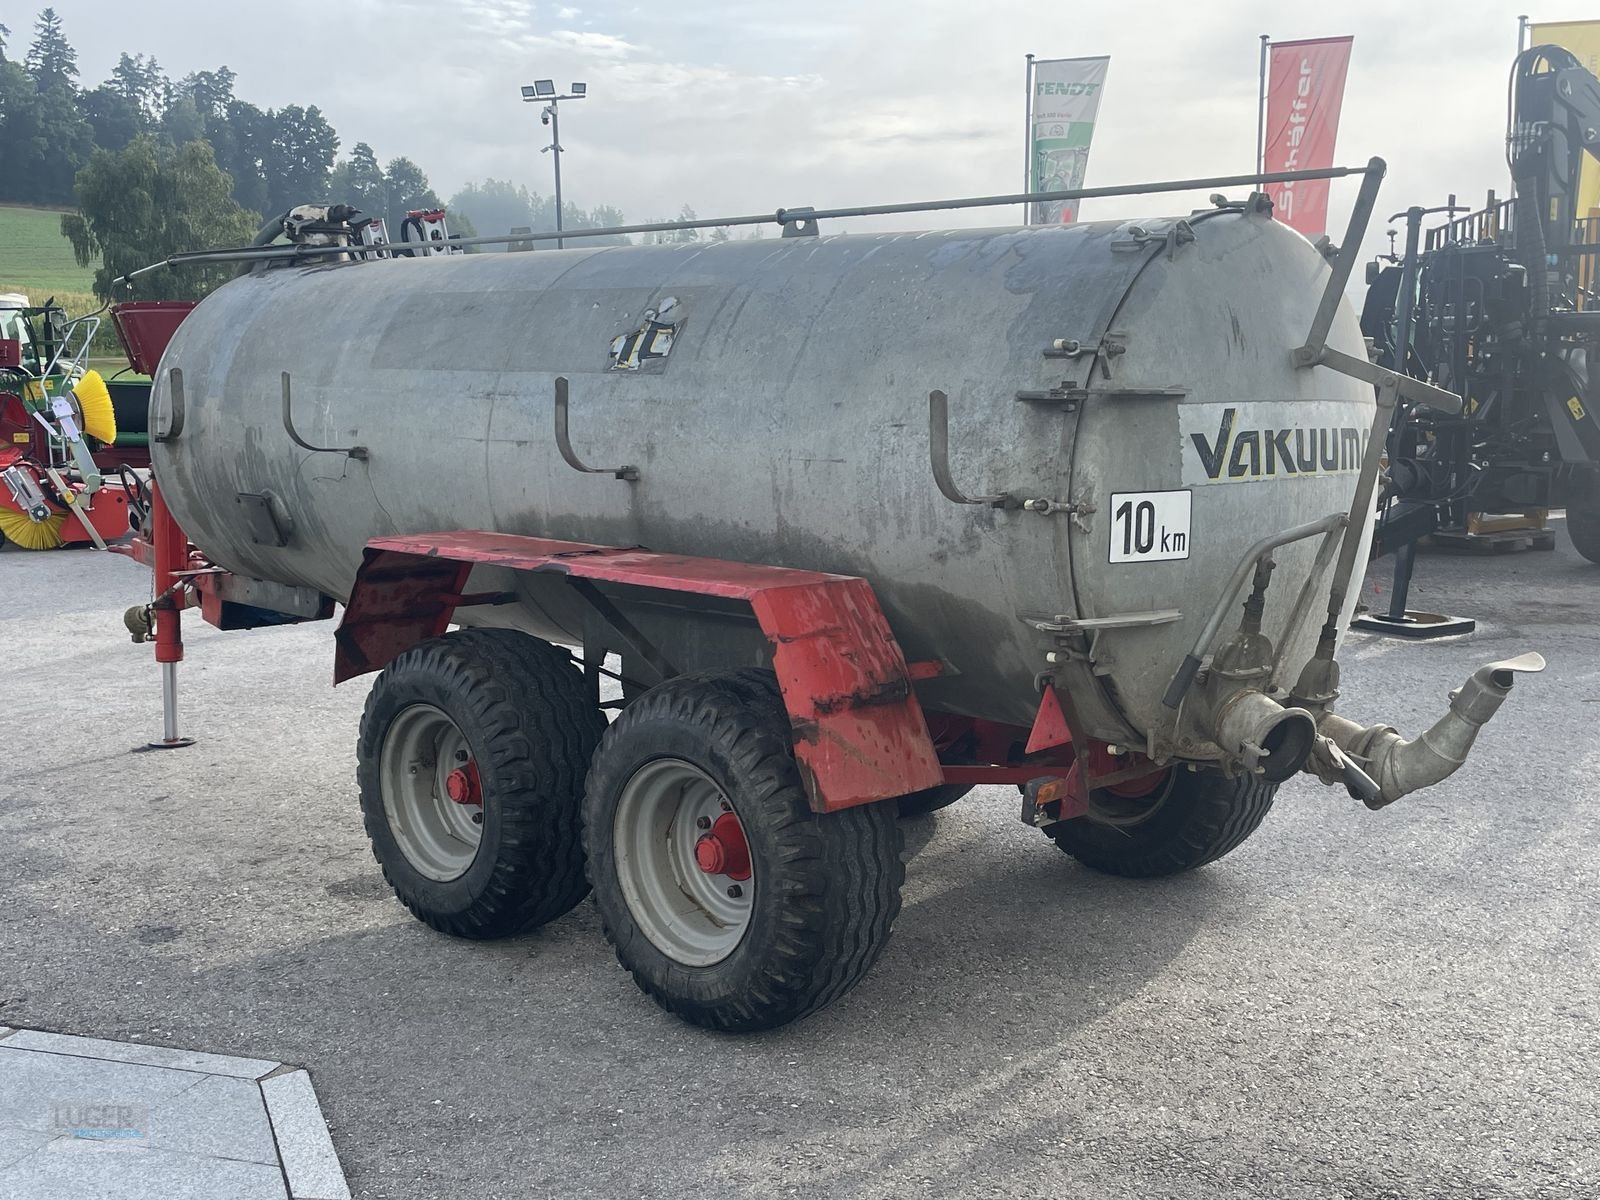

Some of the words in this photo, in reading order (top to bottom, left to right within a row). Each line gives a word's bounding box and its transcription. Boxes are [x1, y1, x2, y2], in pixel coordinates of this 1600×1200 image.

[1036, 82, 1100, 97] FENDT
[1116, 501, 1156, 555] 10
[1161, 525, 1186, 553] km
